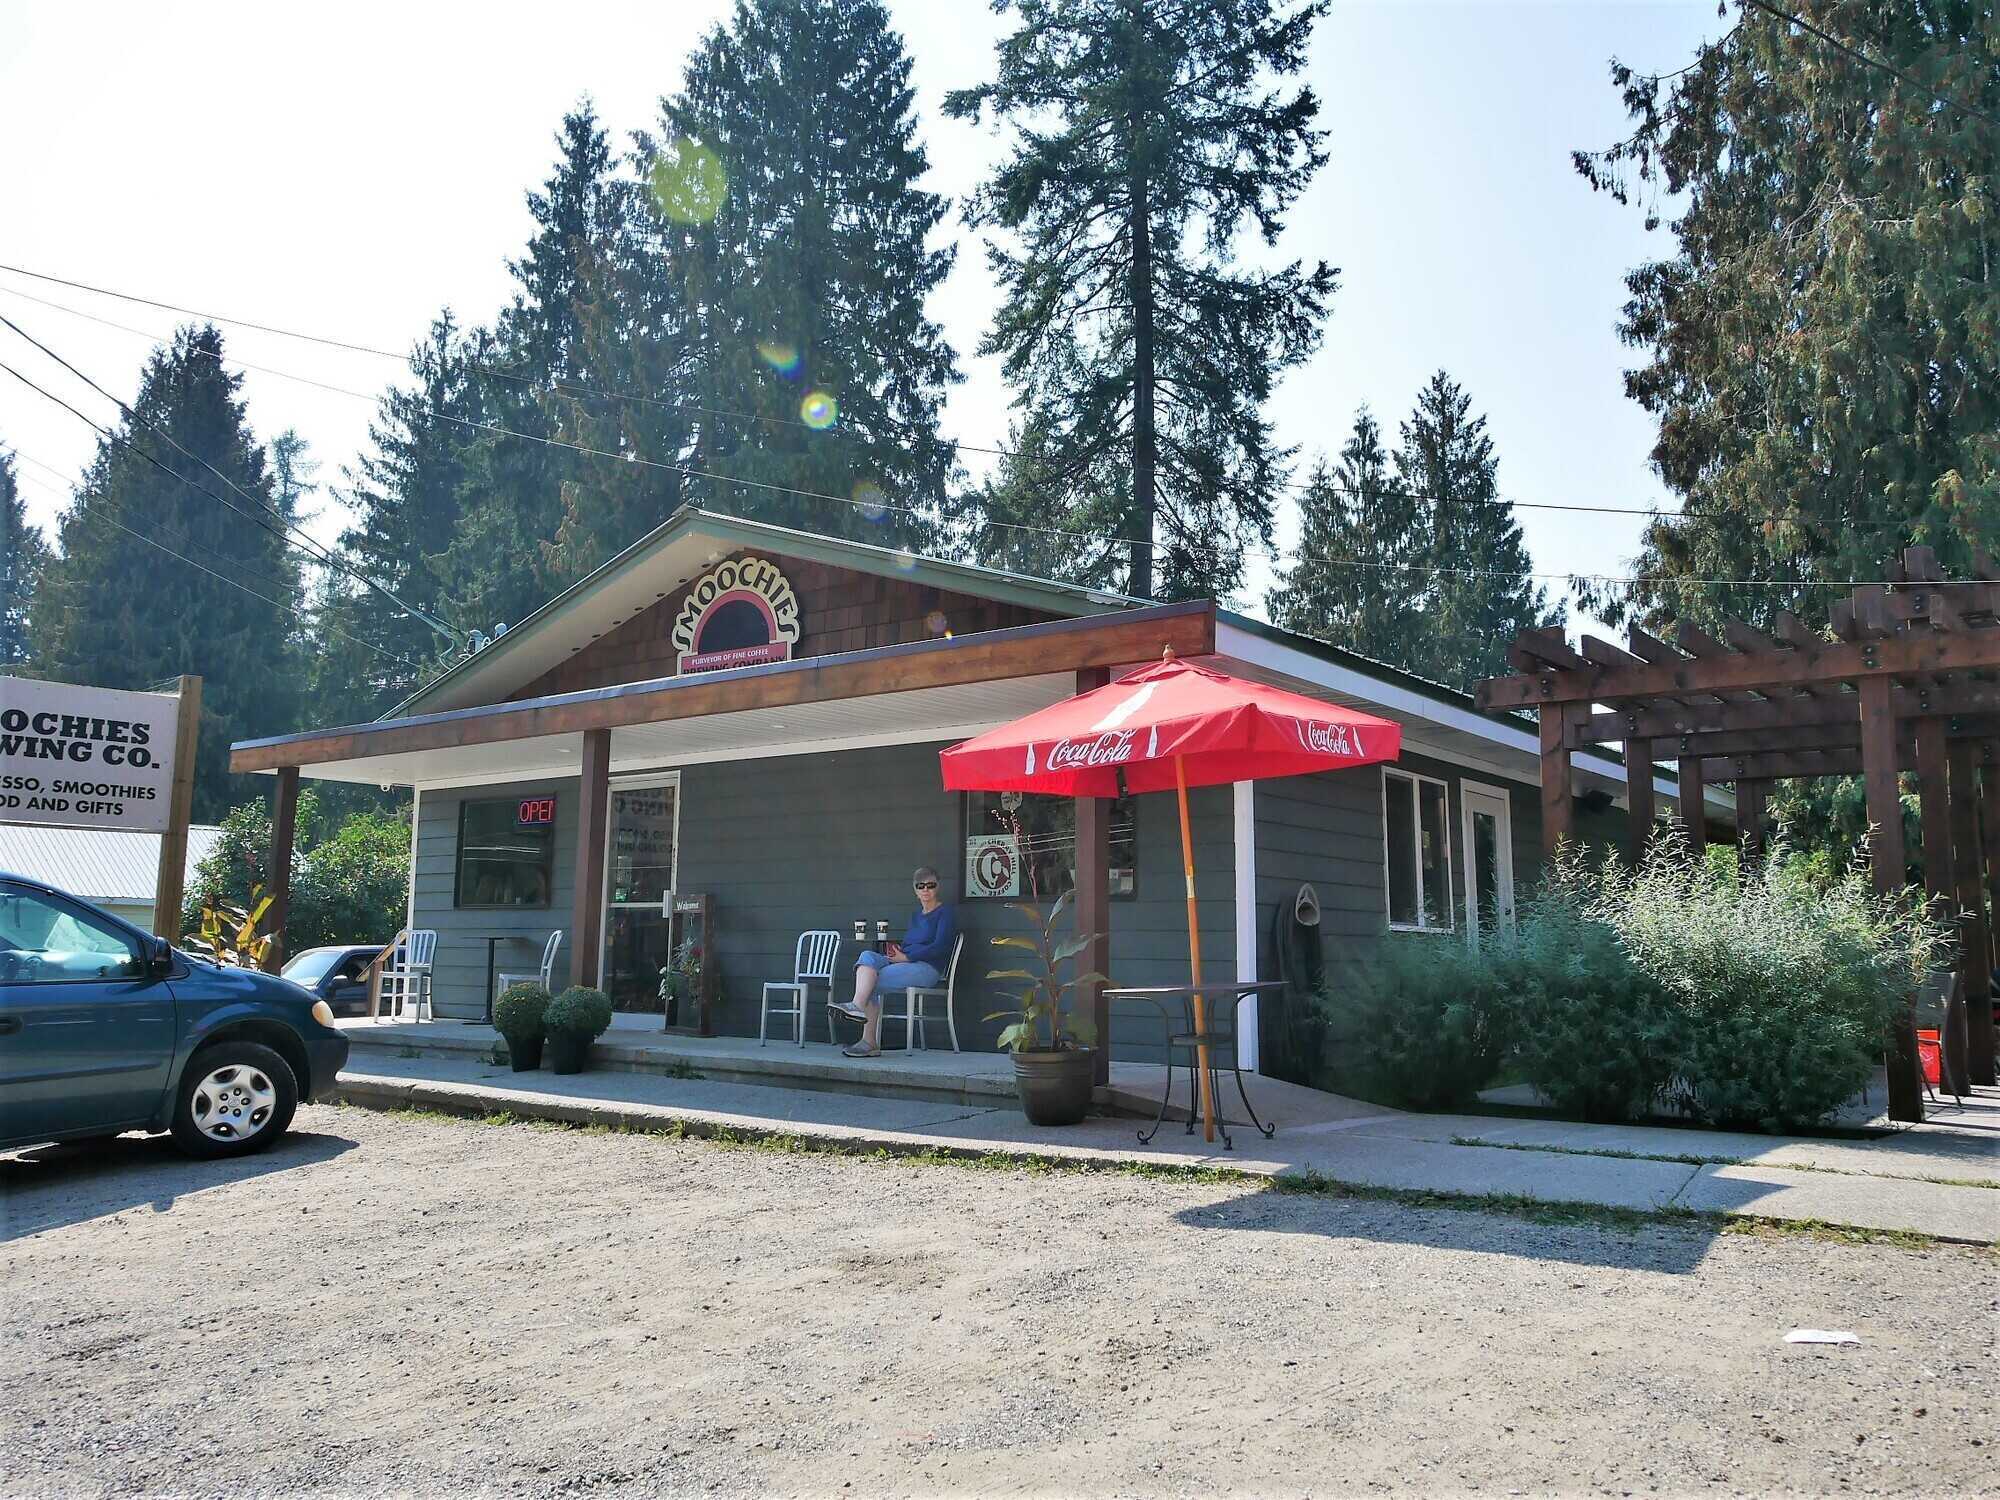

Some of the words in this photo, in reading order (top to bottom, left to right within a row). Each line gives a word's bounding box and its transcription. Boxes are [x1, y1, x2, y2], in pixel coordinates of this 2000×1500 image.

[675, 562, 796, 652] SMOOCHIES
[723, 654, 732, 662] OF
[732, 651, 746, 660] FINE
[747, 648, 769, 658] COFFEE
[1, 709, 151, 745] OCHIES
[1308, 720, 1352, 755] Coca-Cola
[103, 744, 160, 769] CO.
[1046, 728, 1138, 770] Coca-Cola
[0, 775, 46, 794] SSO,
[52, 780, 156, 800] SMOOTHIES
[26, 797, 70, 812] AND
[75, 800, 124, 816] GIFTS
